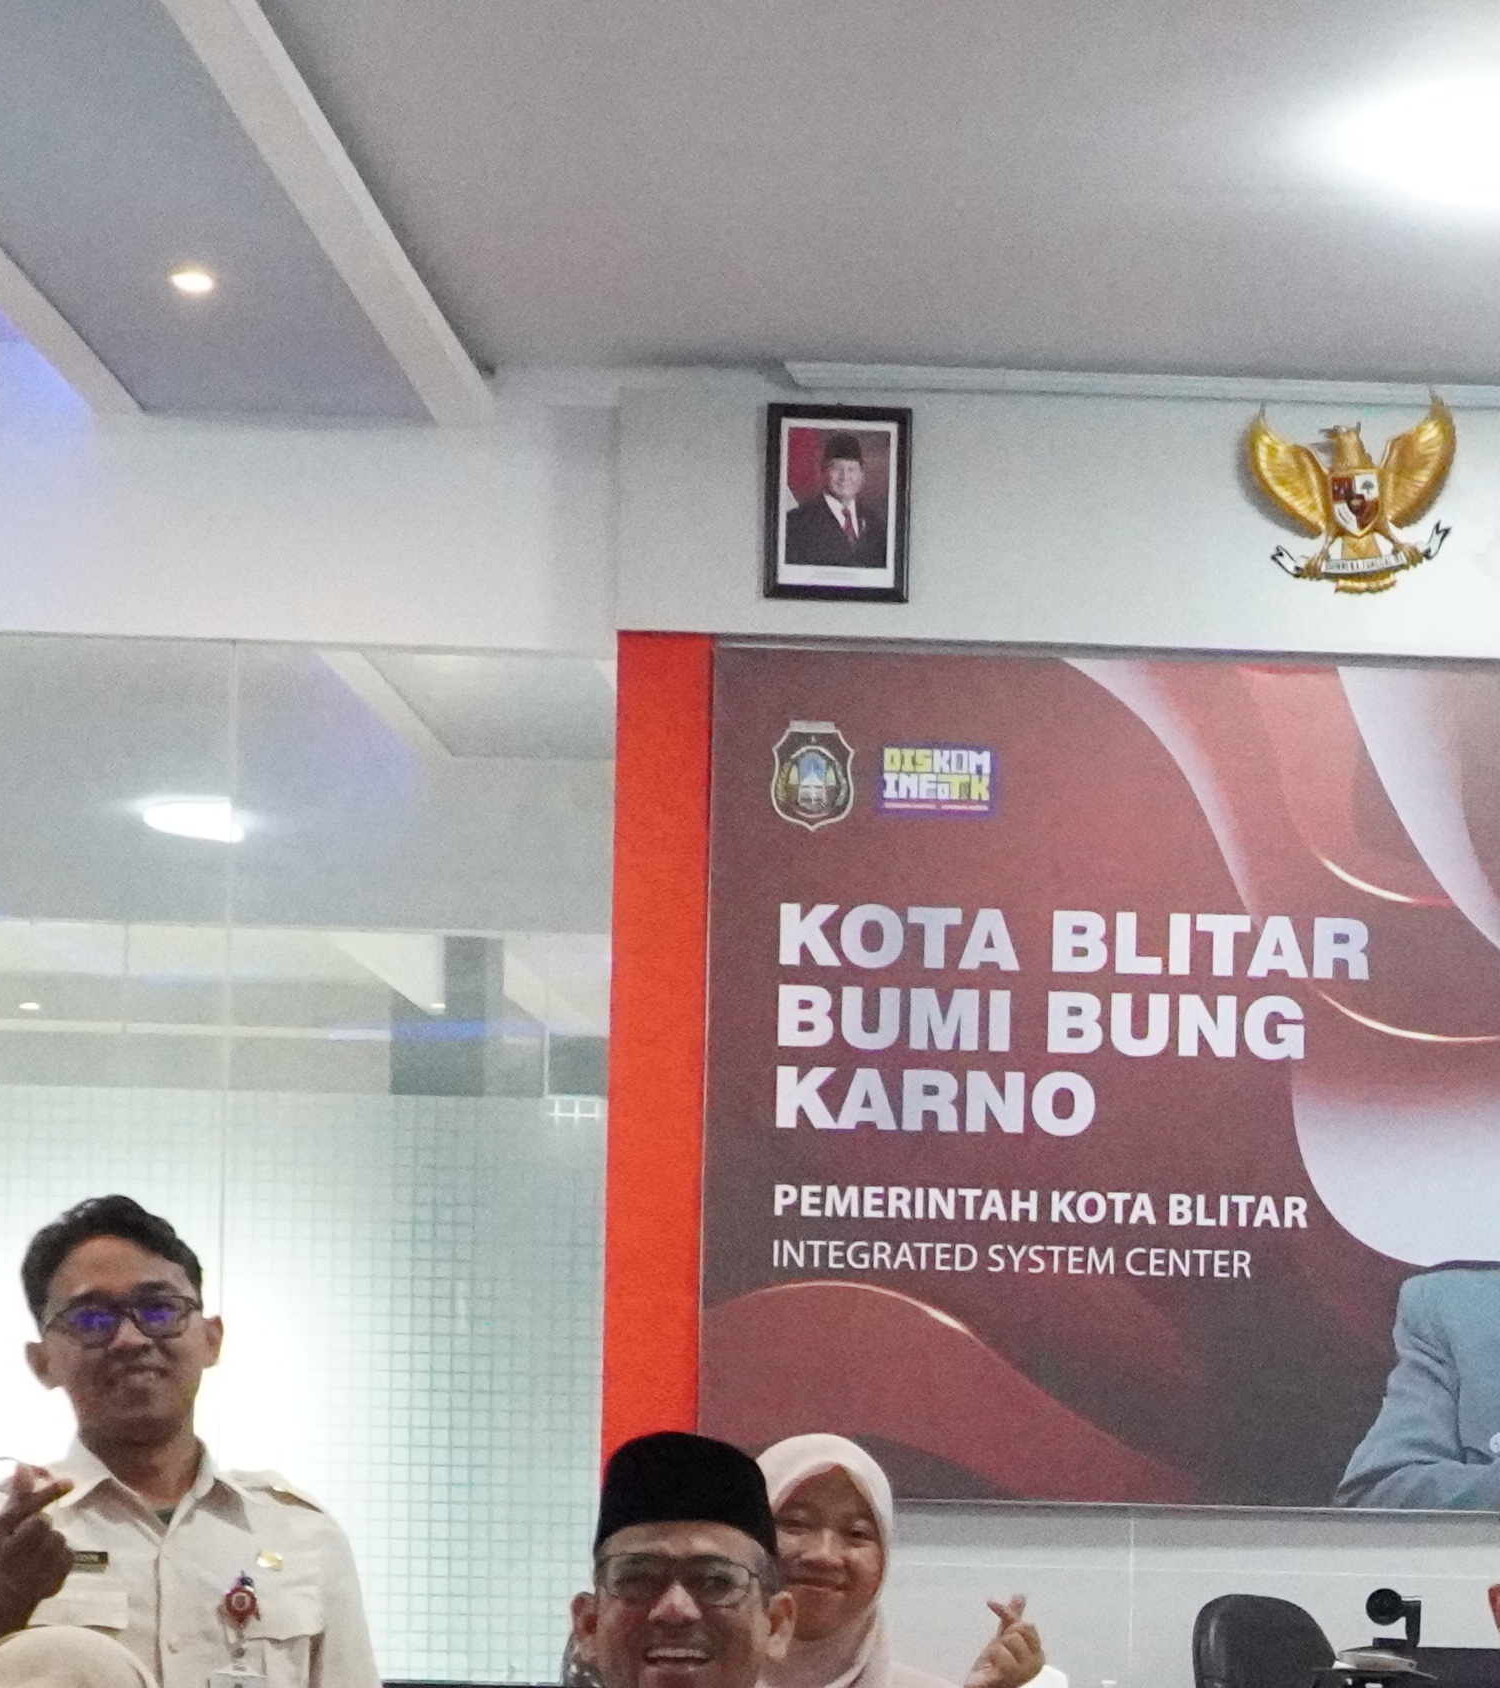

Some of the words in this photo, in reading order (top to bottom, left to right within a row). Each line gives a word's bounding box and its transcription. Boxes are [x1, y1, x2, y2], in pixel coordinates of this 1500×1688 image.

[883, 747, 990, 774] DISKOM
[779, 902, 1020, 972] KOTA
[1051, 909, 1370, 980] BLITAR
[777, 984, 1012, 1052] BUMI
[1047, 990, 1306, 1061] BUNG
[774, 1065, 1097, 1137] KARNO
[773, 1183, 1039, 1223] PEMERINTAH
[1049, 1190, 1158, 1226] KOTA
[1167, 1193, 1309, 1230] BLITAR
[772, 1239, 979, 1273] INTEGRATED
[987, 1243, 1116, 1276] SYSTEM
[1125, 1246, 1252, 1279] CENTER
